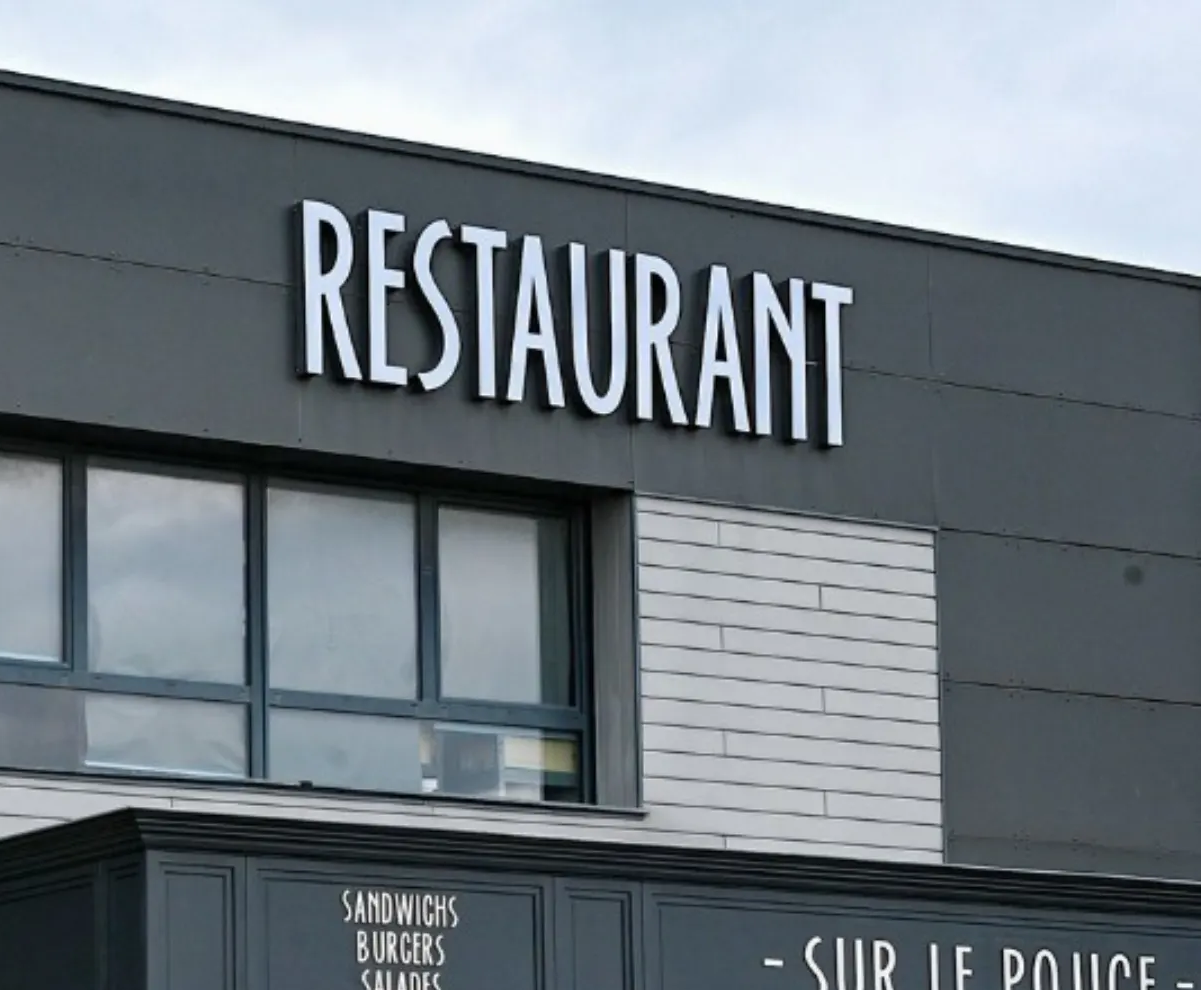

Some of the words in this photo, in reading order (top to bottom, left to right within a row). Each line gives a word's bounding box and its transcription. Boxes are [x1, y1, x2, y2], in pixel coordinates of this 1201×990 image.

[298, 198, 854, 447] RESTAURANT
[342, 889, 460, 928] SANDWICHS
[356, 930, 446, 967] BURGERS
